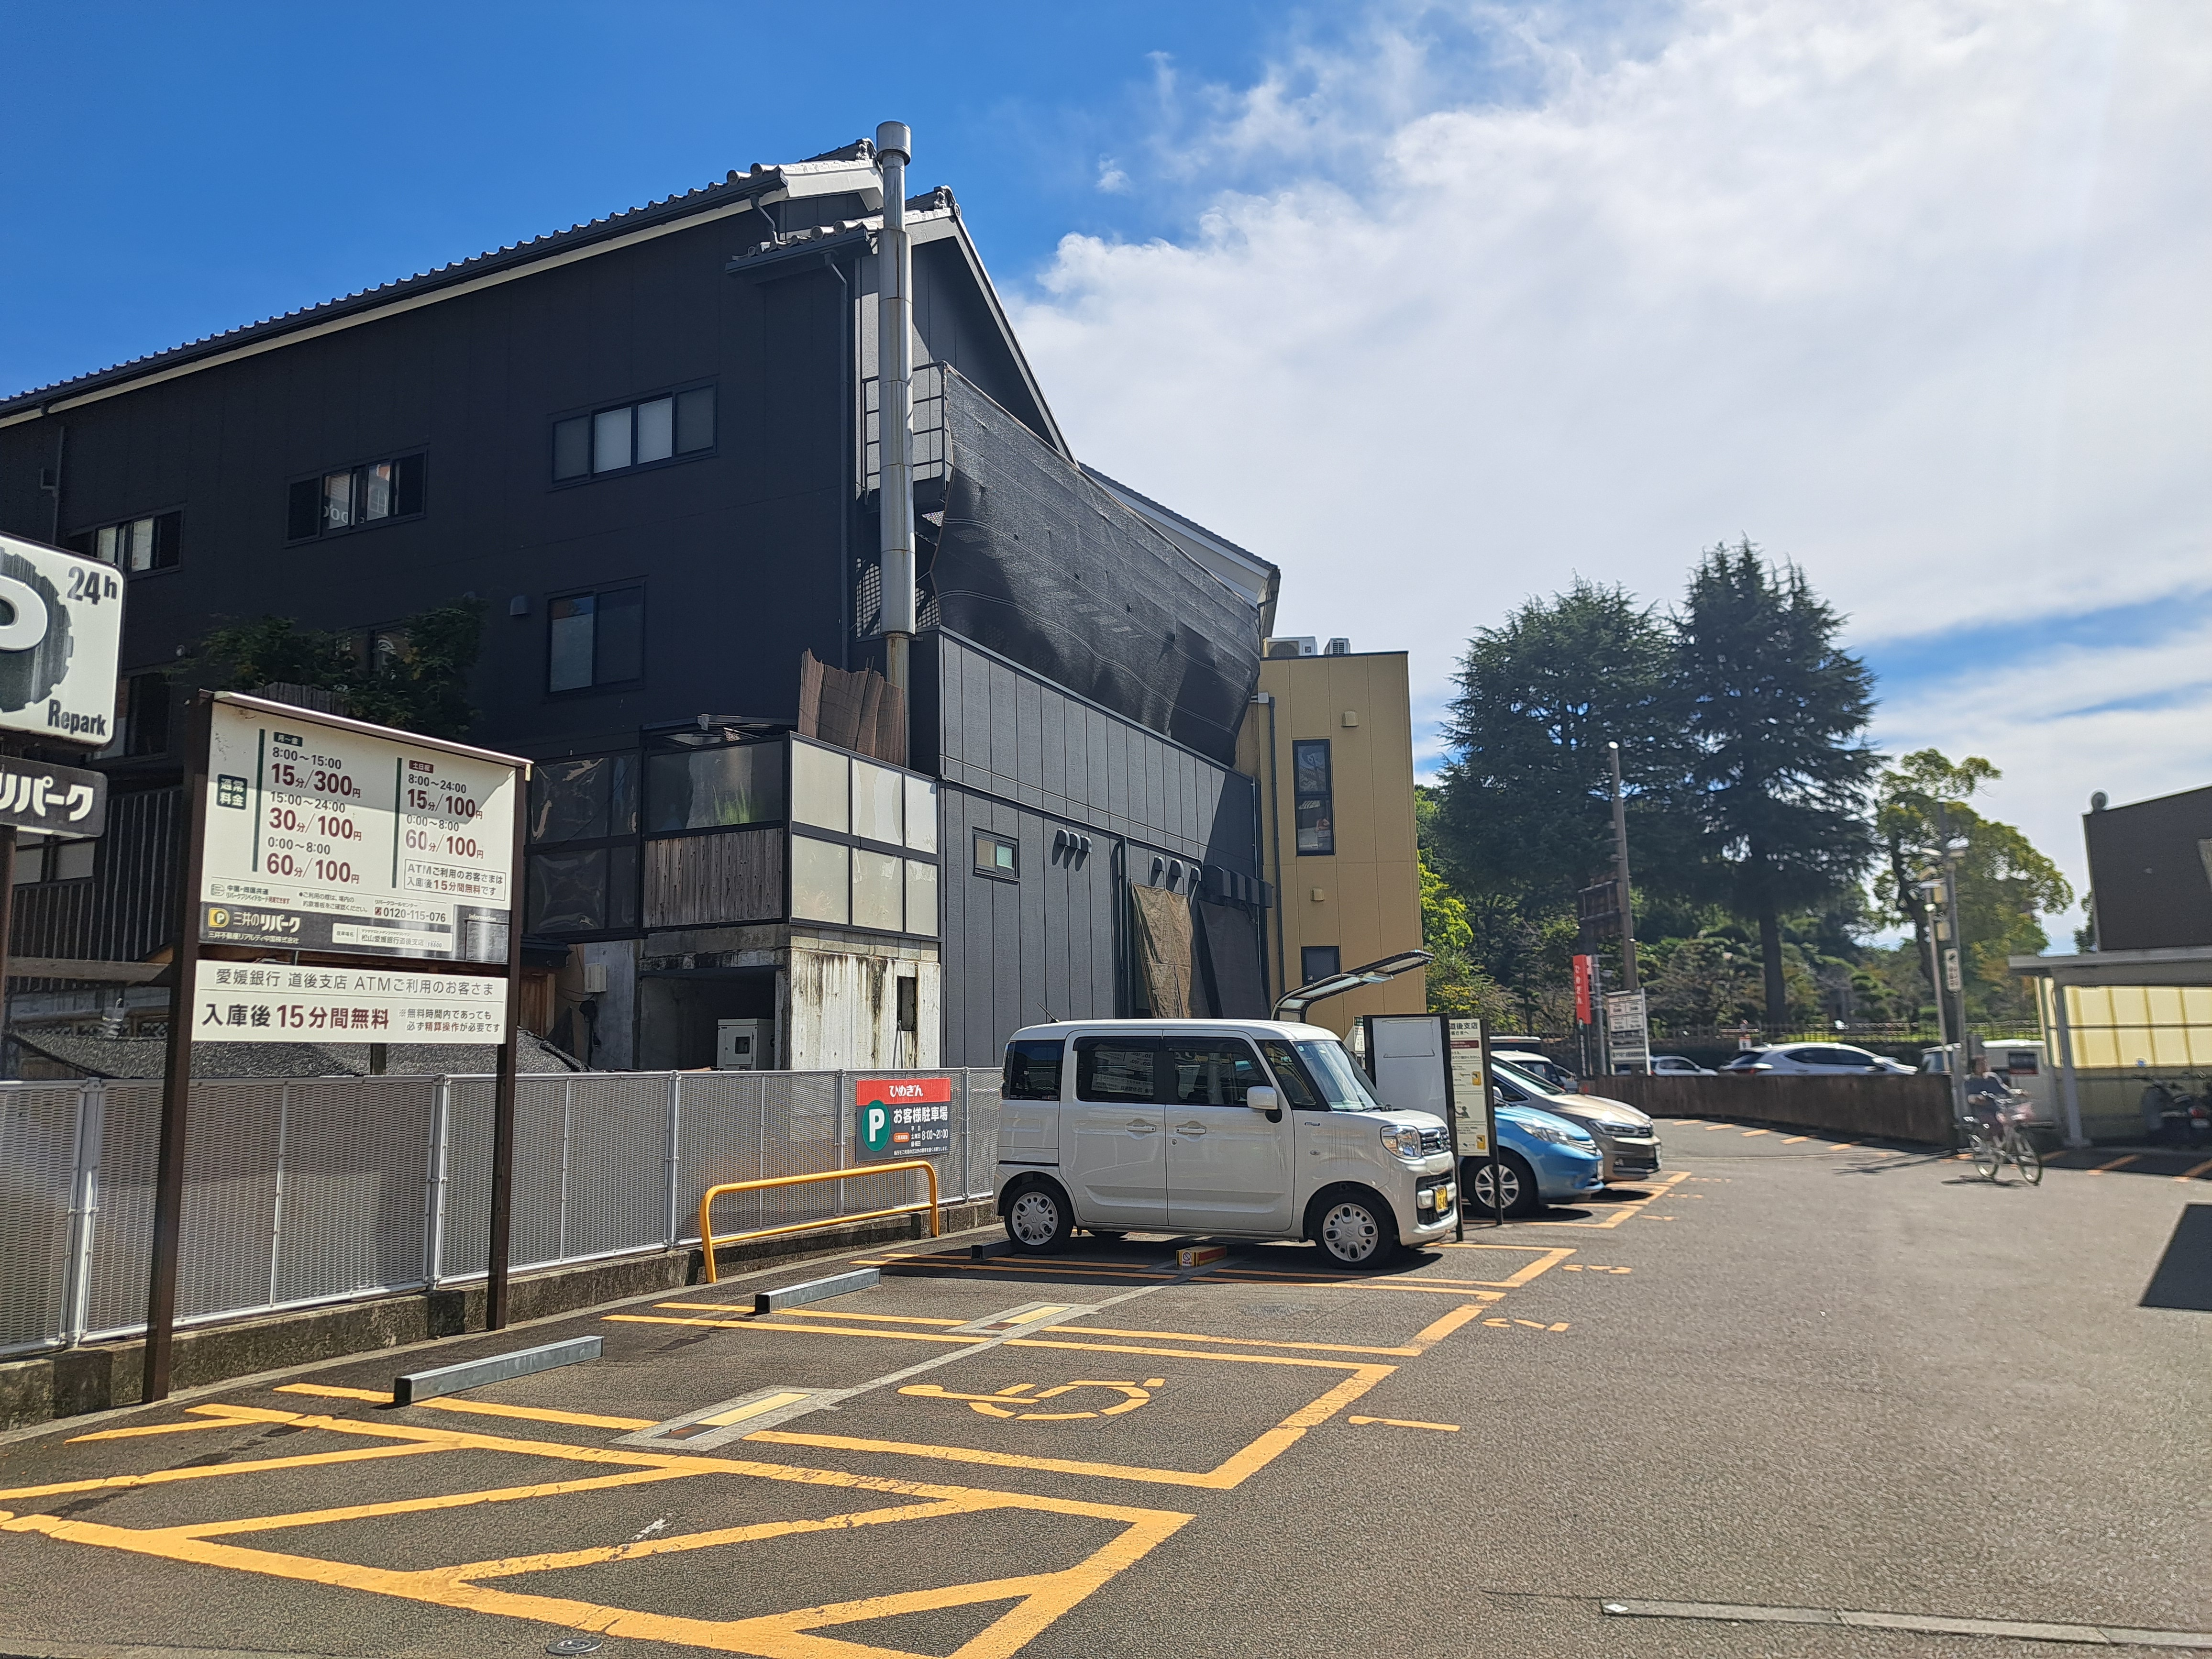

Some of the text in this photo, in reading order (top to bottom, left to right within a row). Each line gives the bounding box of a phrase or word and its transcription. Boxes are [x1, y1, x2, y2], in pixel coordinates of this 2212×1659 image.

[67, 566, 118, 606] 24h
[48, 699, 107, 736] Repark
[383, 907, 446, 922] 0120-115-076
[216, 968, 281, 987] 愛媛銀行
[288, 972, 348, 990] 道後支店
[889, 1084, 923, 1097] ひめぎん
[869, 1108, 885, 1143] P
[893, 1106, 948, 1124] お客様駐車場
